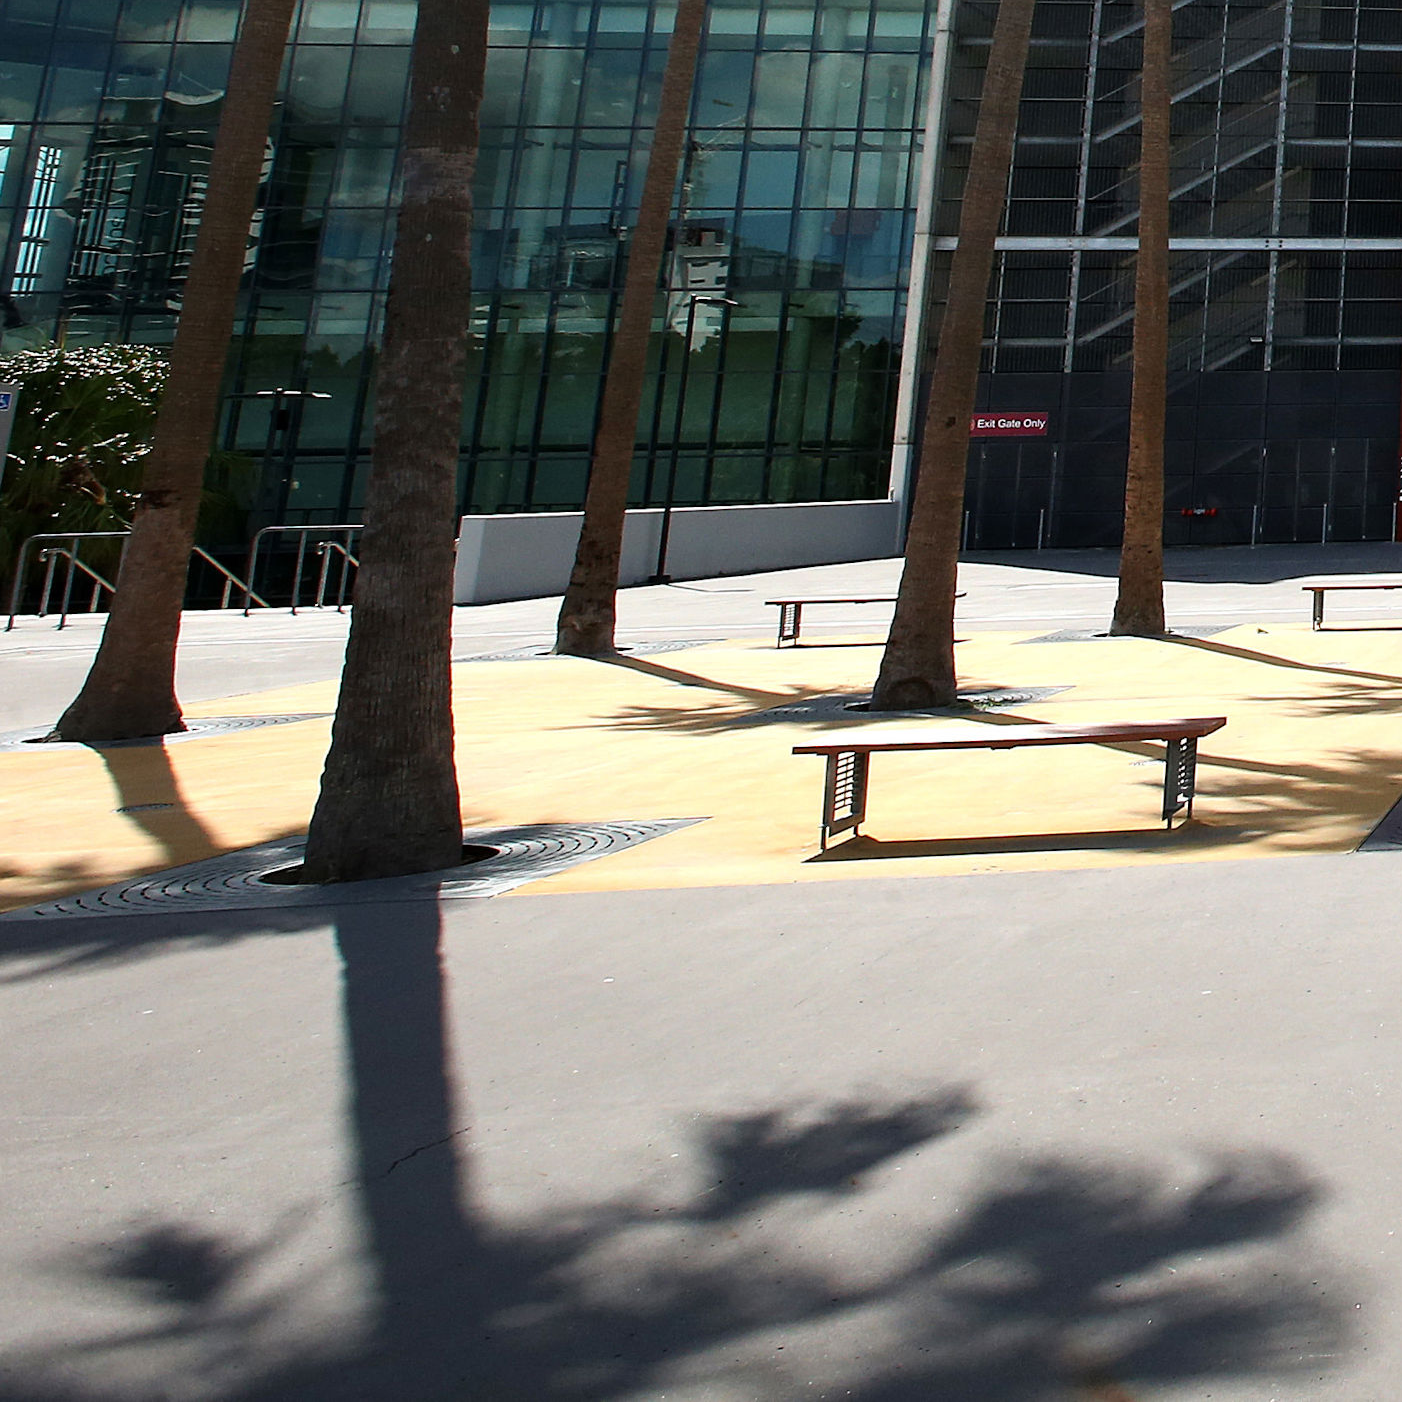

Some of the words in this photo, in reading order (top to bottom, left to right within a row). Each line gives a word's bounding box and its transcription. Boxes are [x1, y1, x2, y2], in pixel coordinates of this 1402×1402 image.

[977, 419, 996, 429] Exit
[997, 418, 1021, 429] Gate
[1023, 418, 1046, 430] Only
